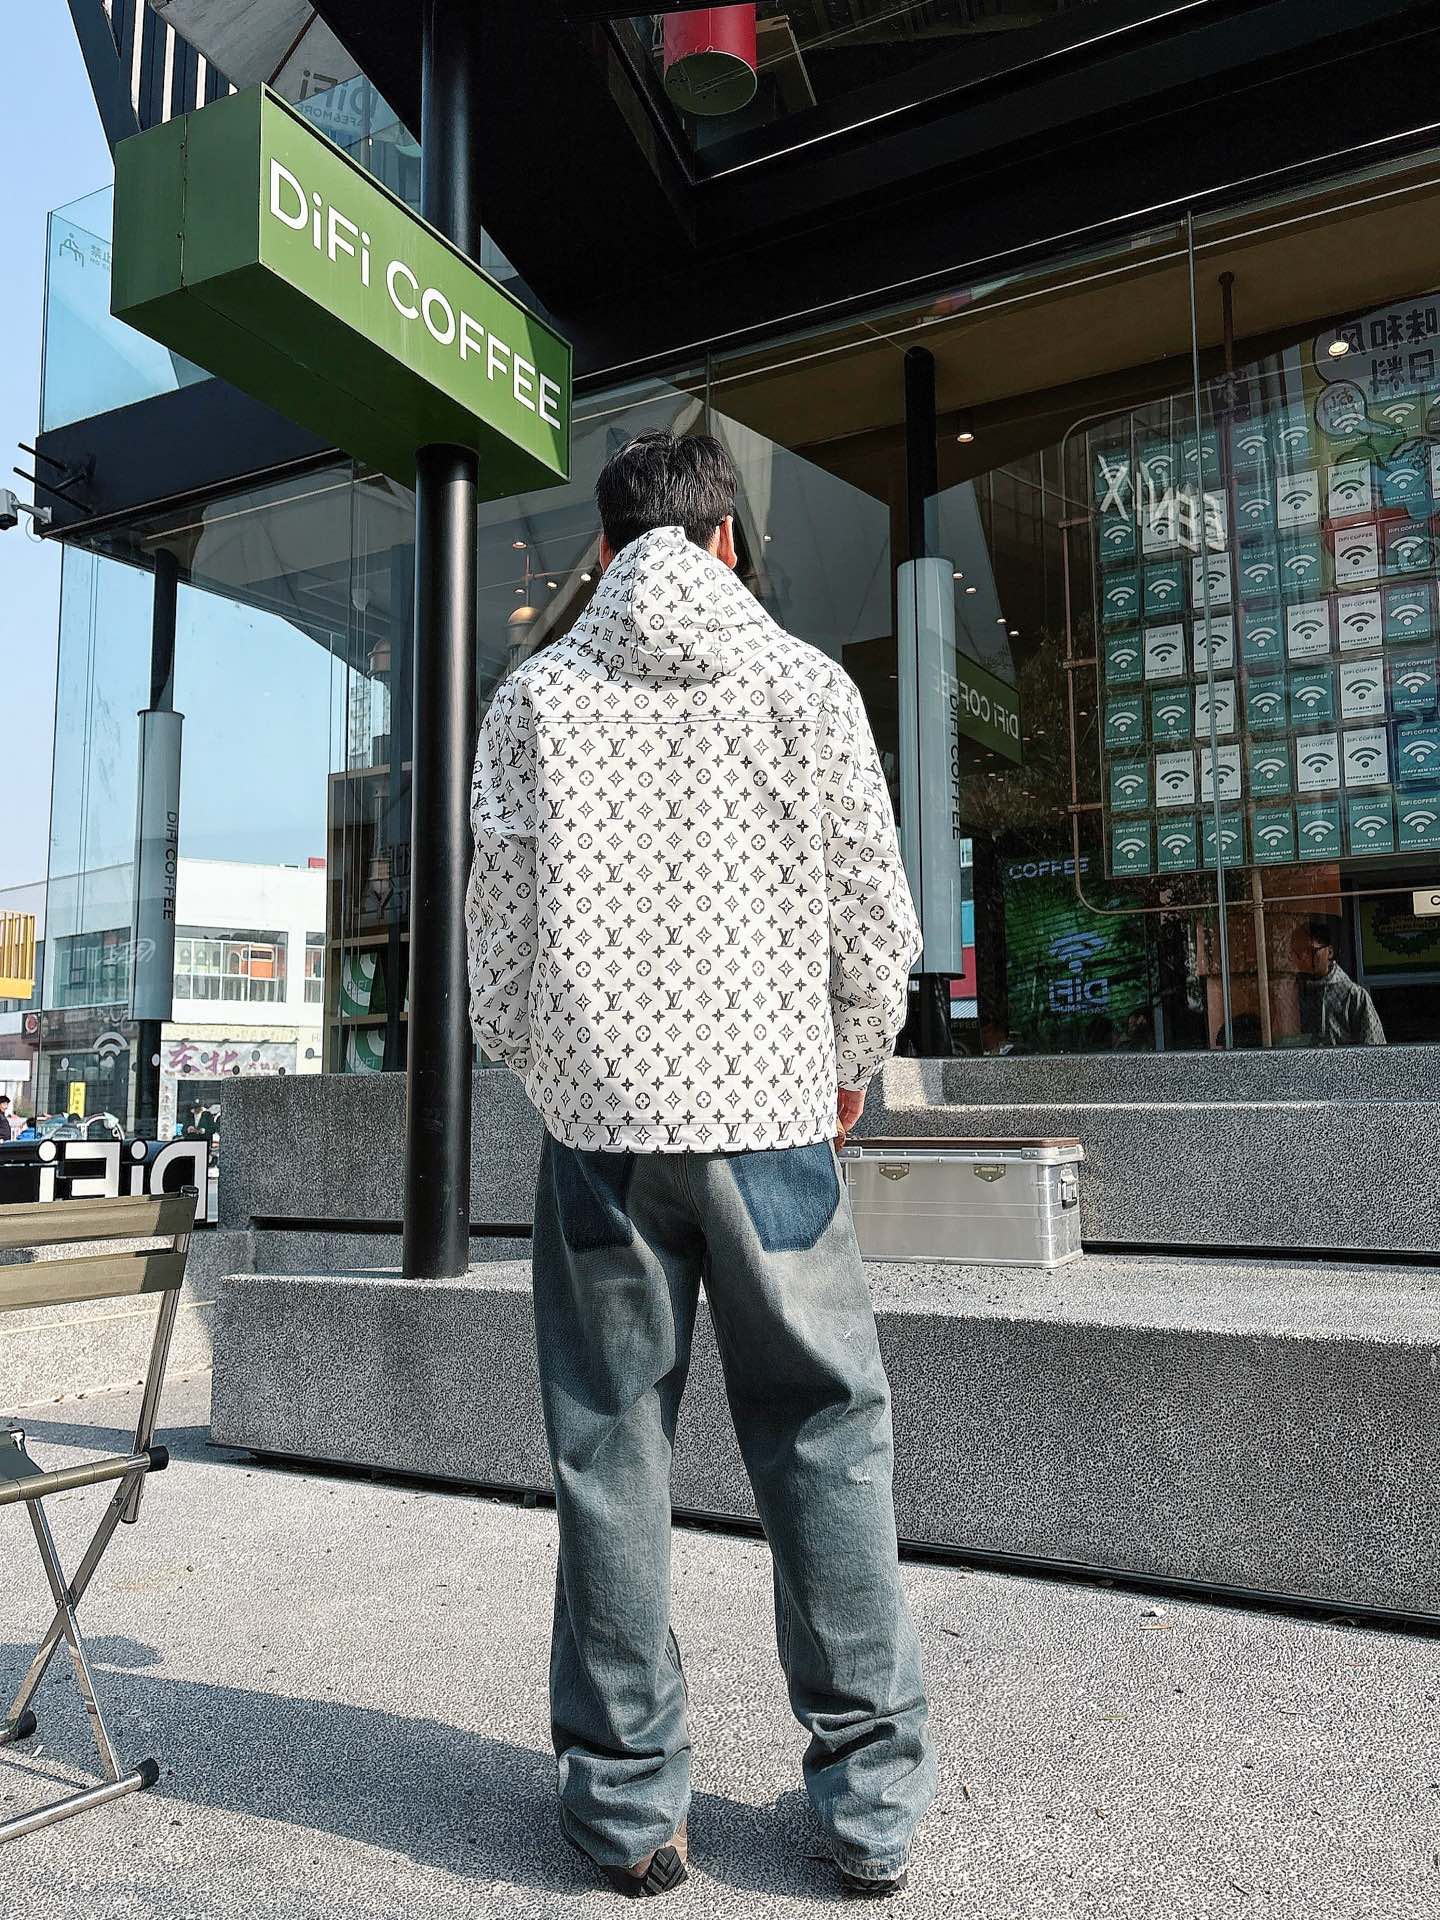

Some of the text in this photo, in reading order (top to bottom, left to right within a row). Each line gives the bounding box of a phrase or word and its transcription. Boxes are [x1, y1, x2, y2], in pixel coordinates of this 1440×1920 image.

[270, 158, 561, 430] DiFi COFFEE
[951, 745, 960, 840] COFFEE
[163, 848, 176, 921] COFFEE
